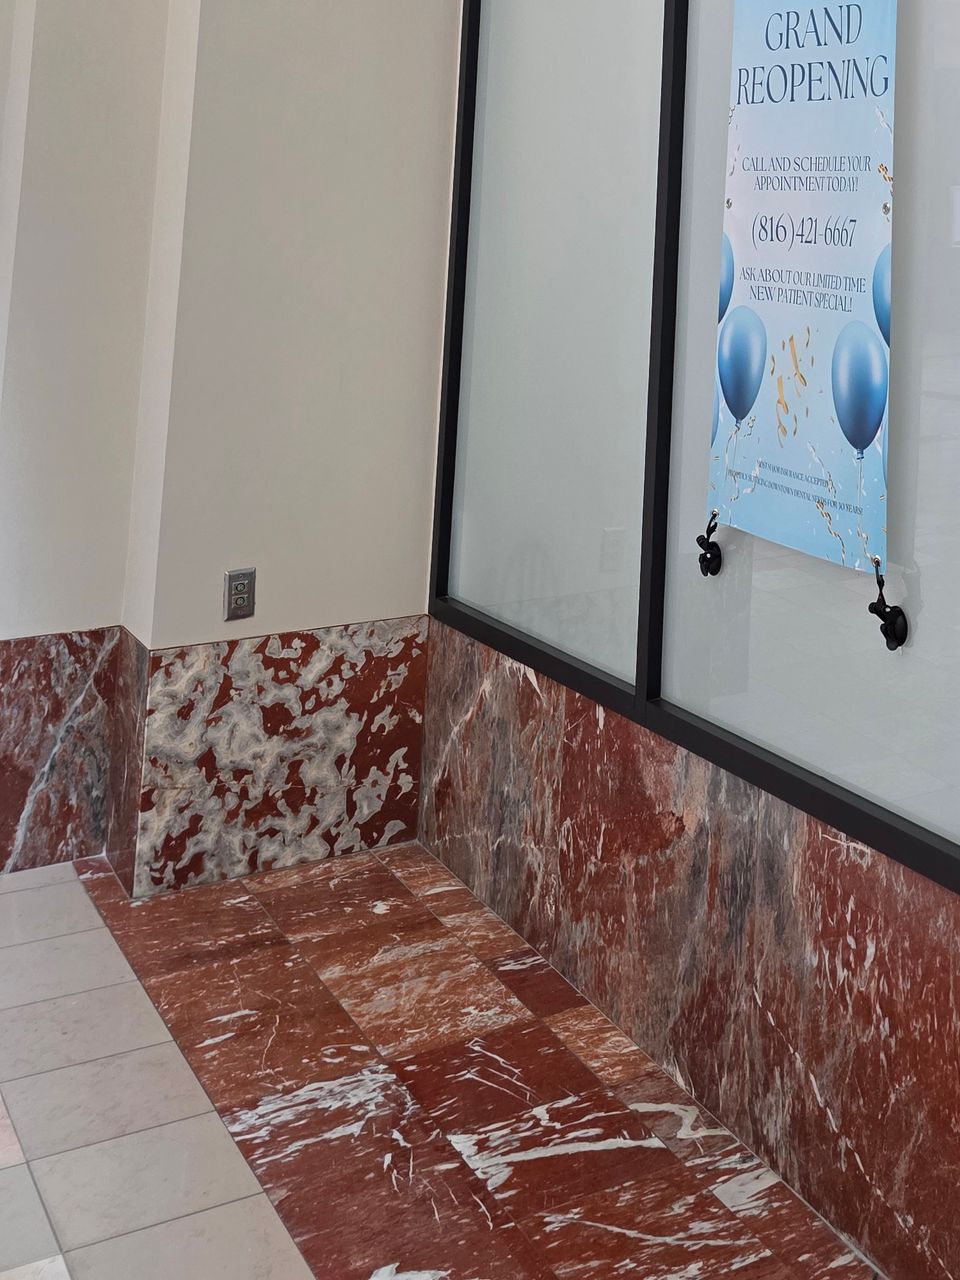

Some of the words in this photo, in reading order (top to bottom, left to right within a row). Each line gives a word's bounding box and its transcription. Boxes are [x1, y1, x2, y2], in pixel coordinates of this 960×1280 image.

[765, 3, 863, 52] GRAND
[736, 54, 889, 105] REOPENING
[742, 156, 767, 172] CALL
[768, 156, 791, 172] AND
[793, 156, 846, 172] SCHEDULE
[847, 155, 872, 172] YOUR
[754, 175, 825, 192] APPOINTMENT
[825, 176, 859, 193] TODAY!
[740, 267, 756, 282] ASK
[756, 268, 793, 285] ABOUT
[792, 270, 814, 287] OUR
[813, 272, 842, 291] LIMITED
[842, 276, 867, 293] TIME
[749, 285, 776, 301] NEW
[777, 287, 814, 307] PATIENT
[814, 291, 853, 313] SPECIAL!
